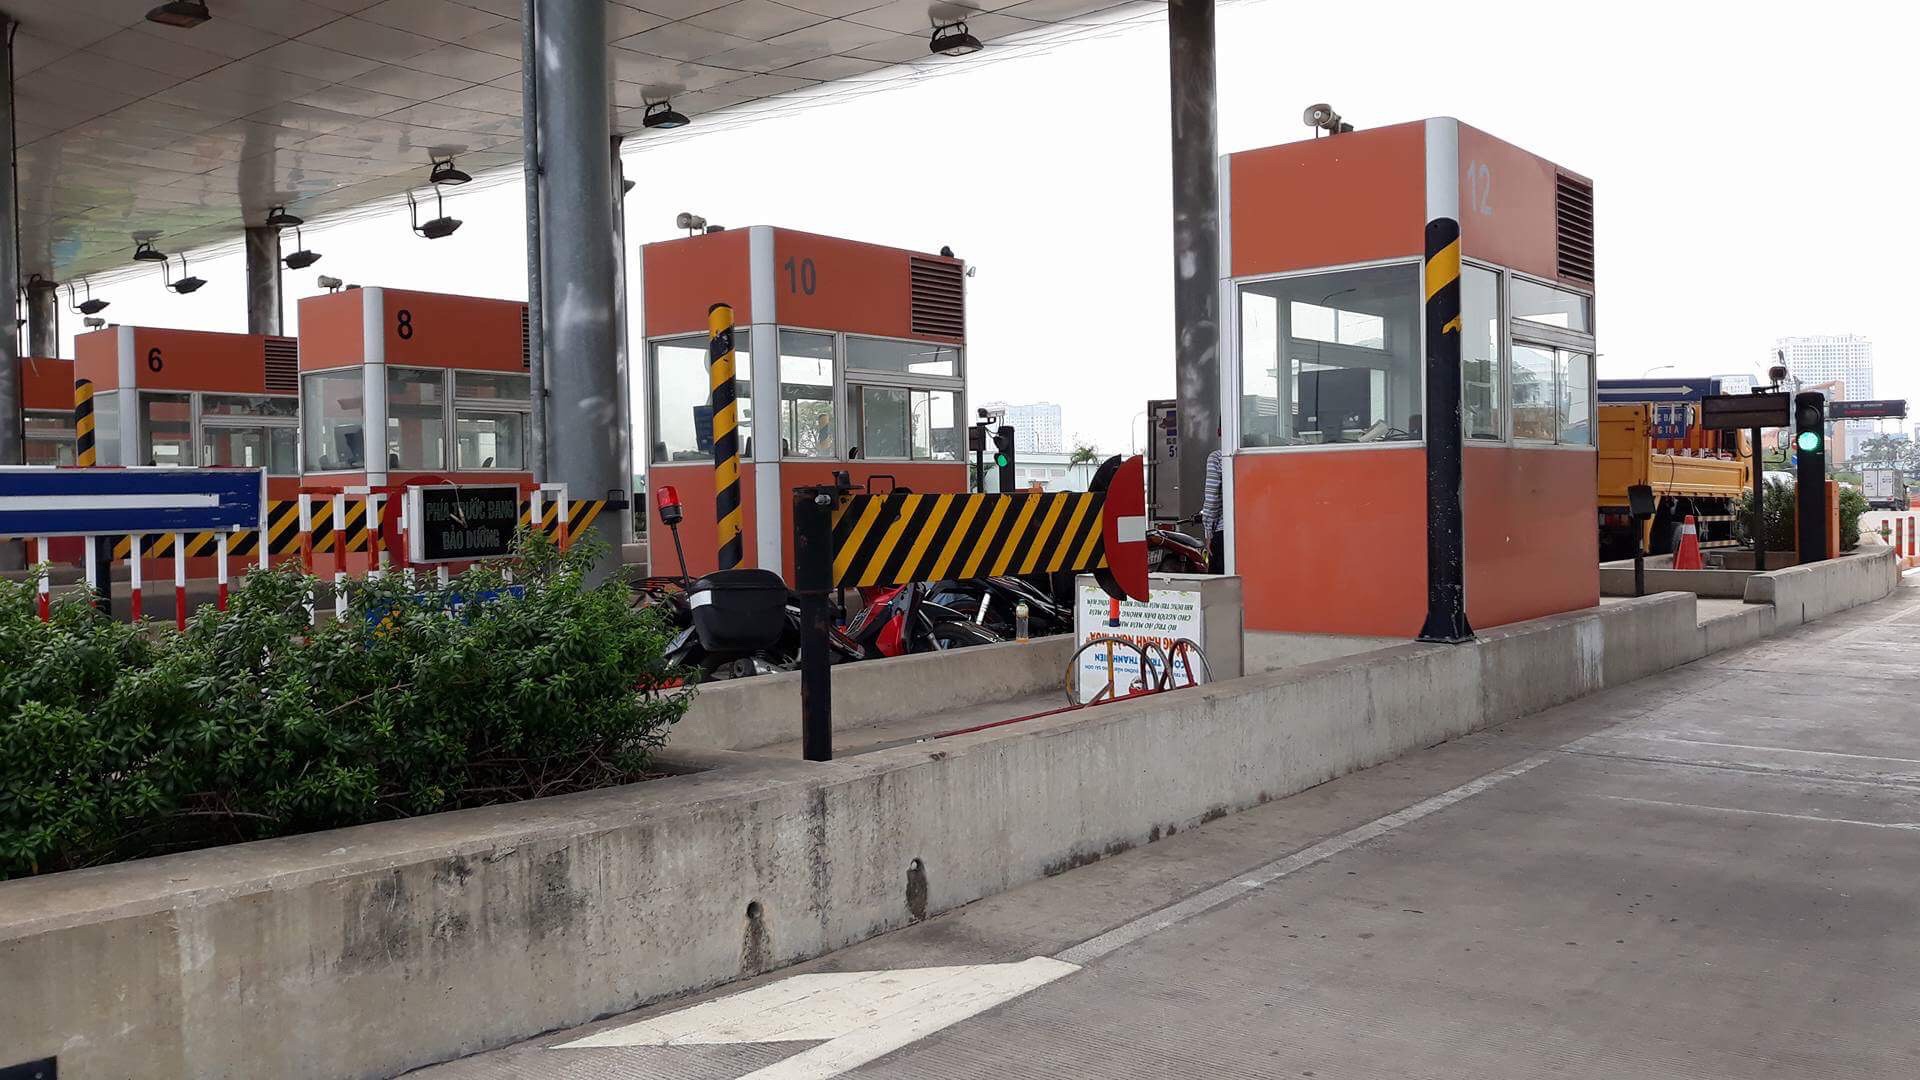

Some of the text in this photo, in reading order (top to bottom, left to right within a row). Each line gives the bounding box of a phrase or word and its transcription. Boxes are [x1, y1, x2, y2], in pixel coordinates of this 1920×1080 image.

[1467, 161, 1493, 215] 12
[784, 256, 817, 296] 10
[397, 310, 414, 340] 8
[148, 347, 164, 374] 6
[1177, 614, 1191, 622] CHO
[1113, 655, 1138, 664] THANH
